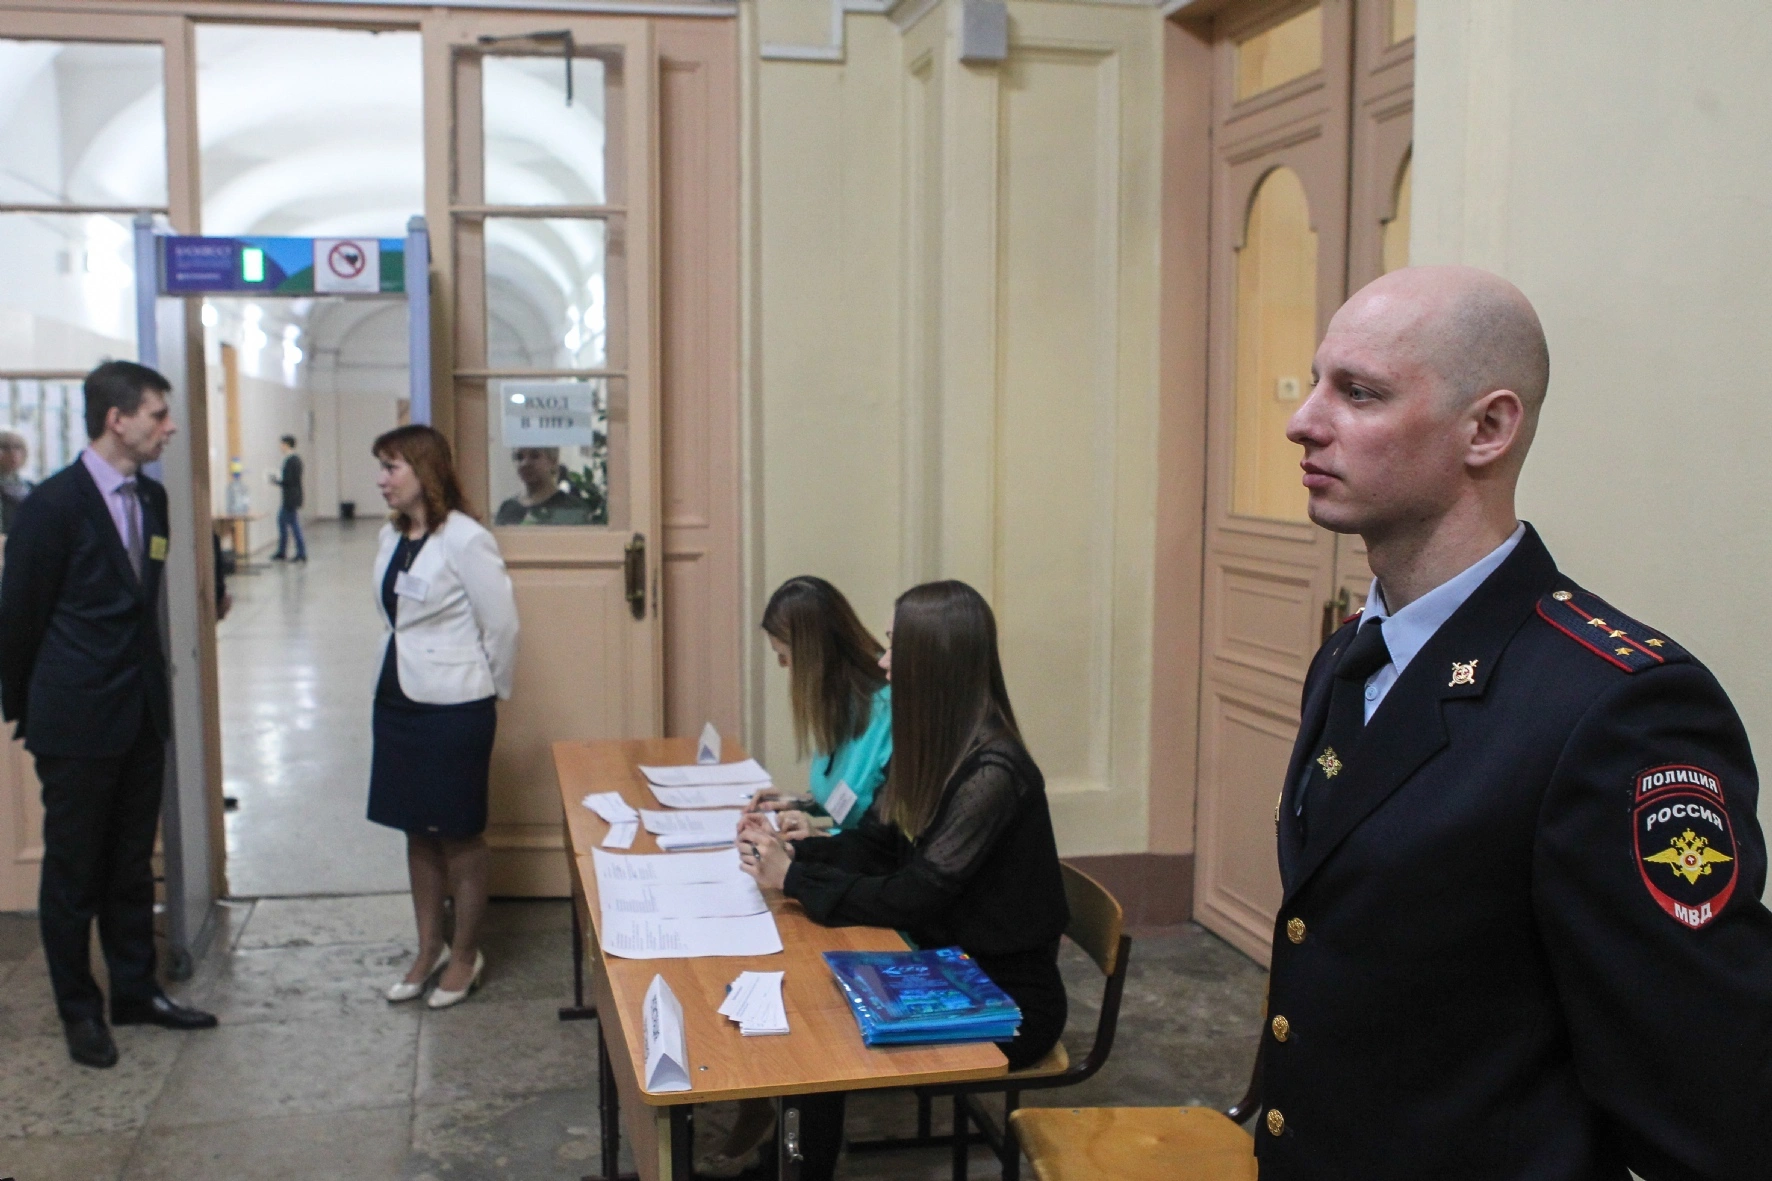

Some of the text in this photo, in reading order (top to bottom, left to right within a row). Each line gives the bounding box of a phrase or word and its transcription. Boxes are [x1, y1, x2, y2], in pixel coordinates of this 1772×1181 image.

[1642, 770, 1718, 793] ПОЛИЦИЯ
[1646, 803, 1724, 832] РОССИЯ
[1674, 902, 1712, 926] МВД
